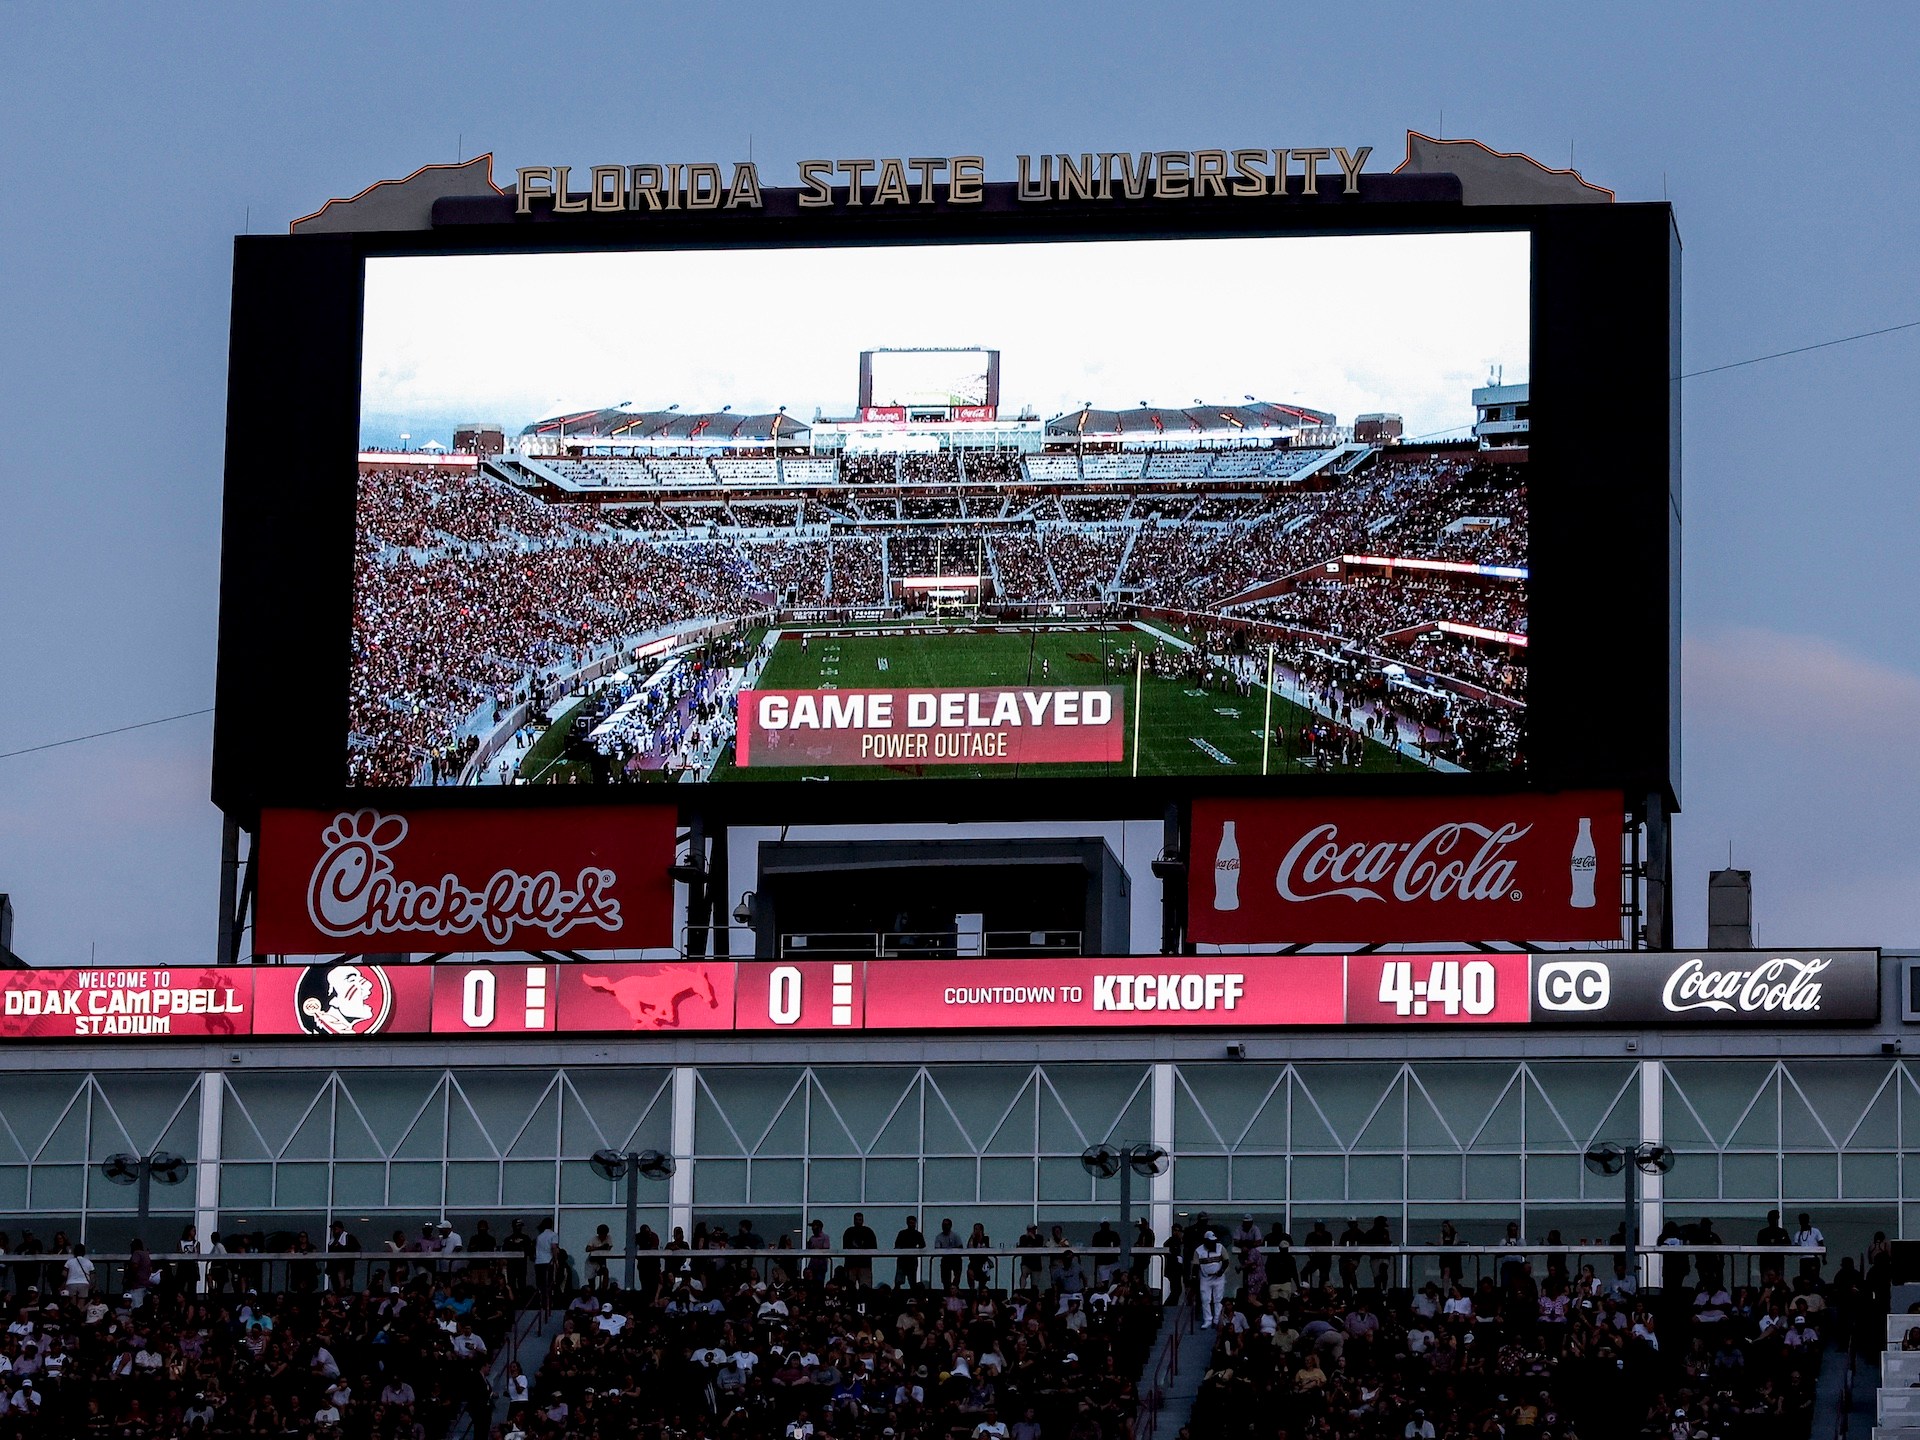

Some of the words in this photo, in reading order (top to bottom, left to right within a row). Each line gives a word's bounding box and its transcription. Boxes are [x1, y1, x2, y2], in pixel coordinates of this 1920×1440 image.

[515, 162, 763, 214] FLORIDA
[798, 156, 984, 207] STATE
[1016, 147, 1373, 201] UNIVERSITY
[758, 693, 893, 730] GAME
[907, 690, 1113, 728] DELAYED
[861, 733, 928, 759] POWER
[934, 732, 1008, 758] OUTAGE
[308, 808, 623, 945] Chick-fil-A
[1275, 822, 1533, 904] Coca-Cola
[4, 991, 83, 1015] DOAK
[88, 989, 244, 1014] CAMPBELL
[78, 972, 149, 989] WELCOME
[153, 971, 170, 987] TO
[462, 969, 496, 1028] 0
[768, 965, 803, 1025] 0
[944, 986, 1055, 1004] COUNTDOWN
[1060, 986, 1083, 1003] TO
[1093, 974, 1244, 1011] KICKOFF
[1378, 960, 1495, 1016] 4:40
[1544, 969, 1604, 1006] CC
[1662, 958, 1832, 1013] Coca-Cola
[75, 1015, 171, 1035] STADIUM
